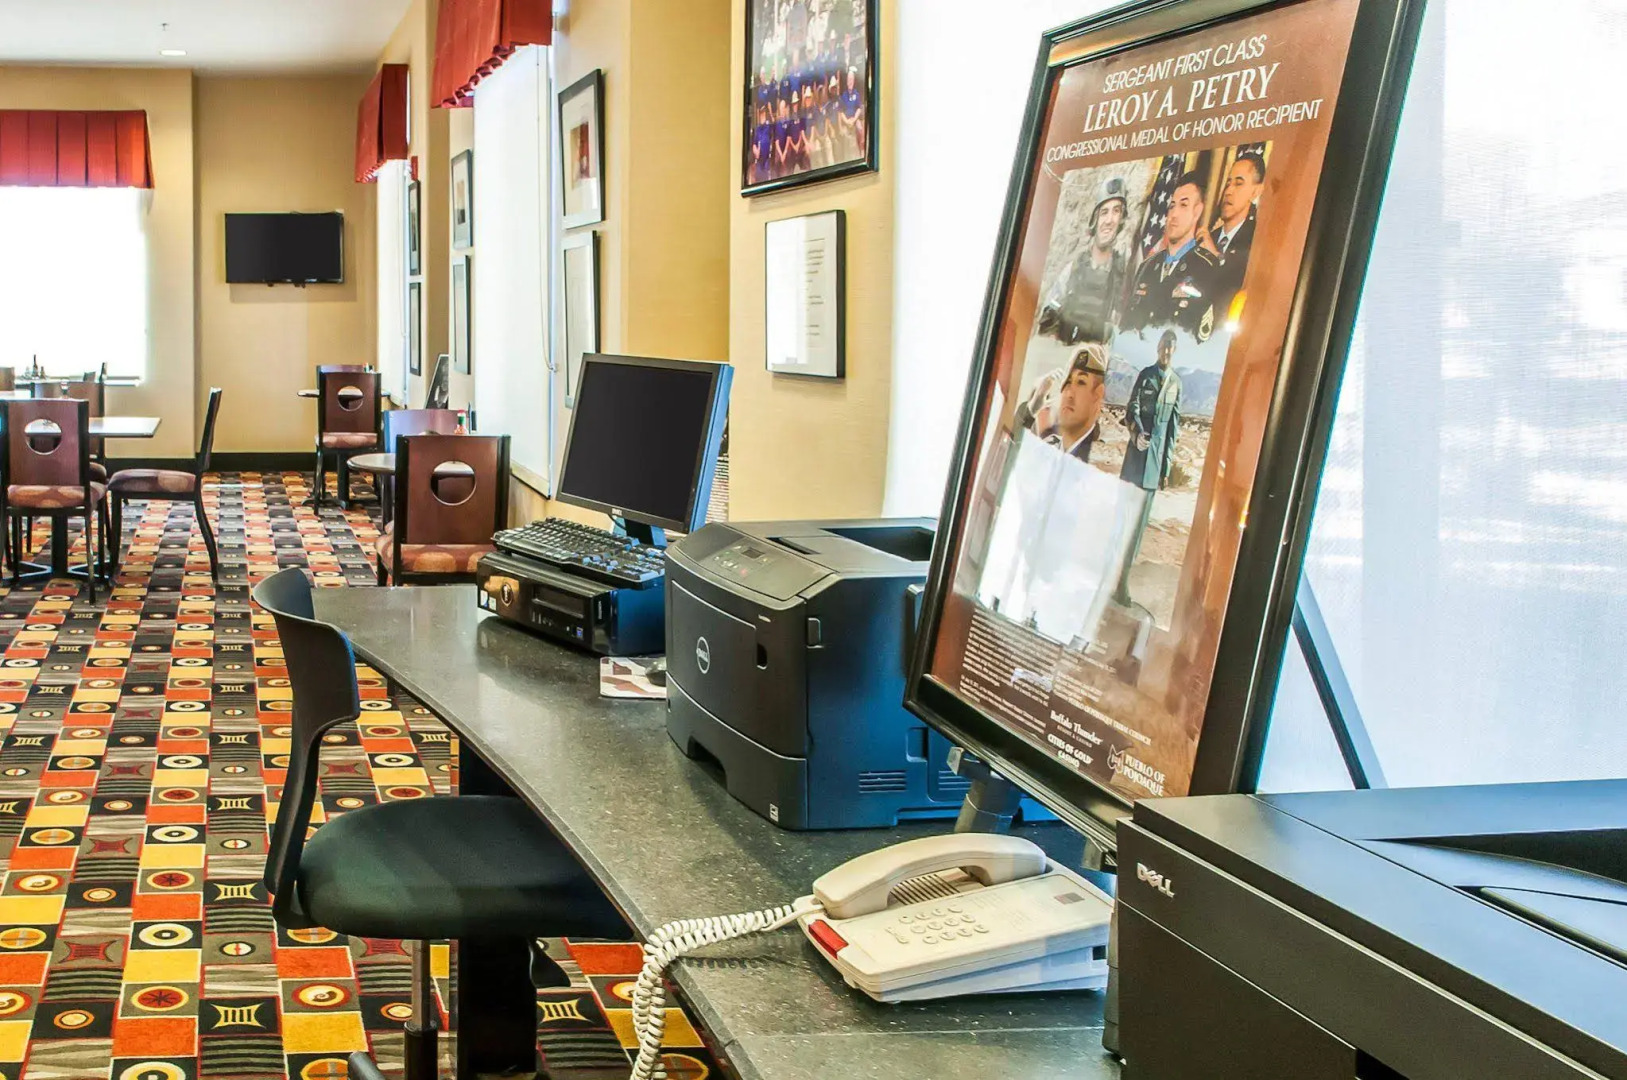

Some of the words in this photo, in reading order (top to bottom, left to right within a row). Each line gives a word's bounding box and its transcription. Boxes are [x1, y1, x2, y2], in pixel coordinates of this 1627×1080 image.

[1103, 58, 1173, 94] SERGEANT
[1173, 48, 1212, 76] FIRST
[1212, 34, 1267, 67] CLASS
[1082, 89, 1157, 133] LEROY
[1155, 86, 1178, 118] A.
[1186, 62, 1280, 113] PETRY
[1046, 134, 1128, 163] CONGRESSIONAL
[1130, 125, 1169, 148] MEDAL
[1172, 119, 1191, 140] OF
[1192, 112, 1244, 138] HONOR
[1246, 99, 1323, 128] RECIPIENT
[1073, 722, 1104, 745] Thunder
[1125, 754, 1154, 777] PUEBLO
[1153, 770, 1166, 785] OF
[1136, 862, 1176, 899] DELL
